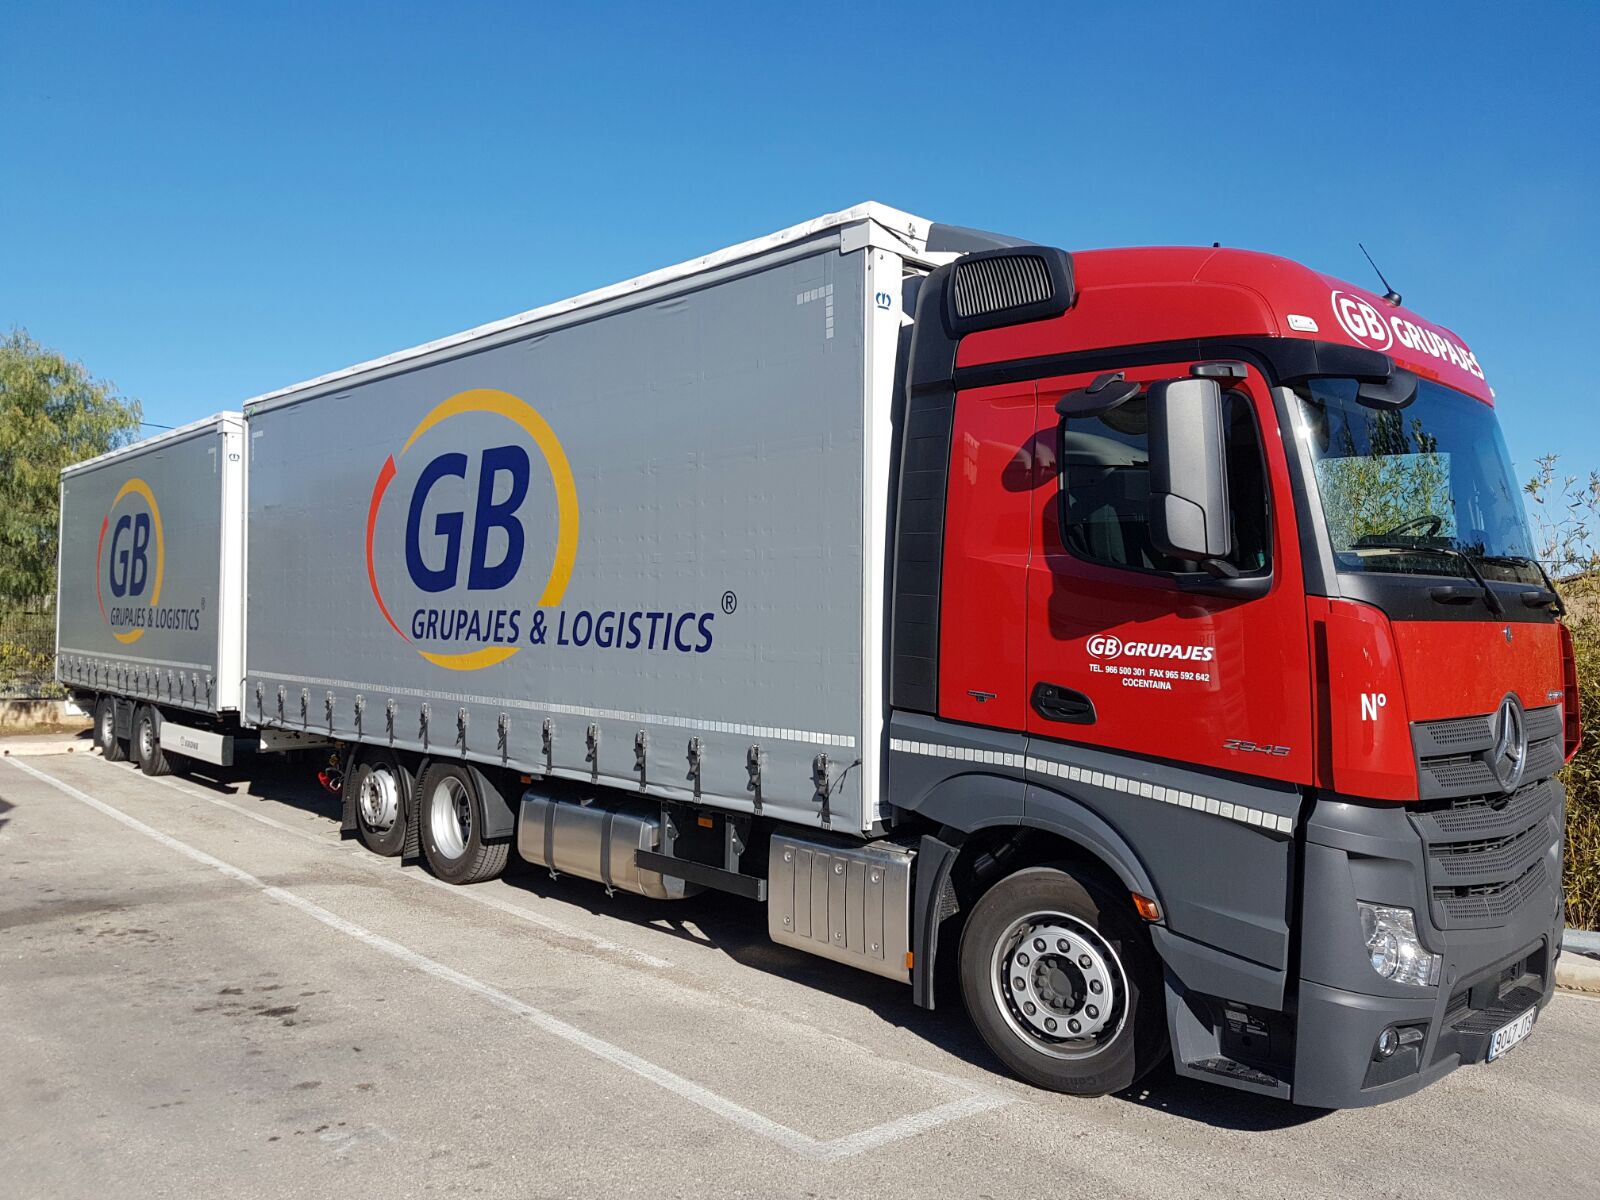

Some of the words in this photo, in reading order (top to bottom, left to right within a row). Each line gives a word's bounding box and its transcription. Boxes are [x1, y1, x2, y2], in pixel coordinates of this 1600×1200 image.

[1339, 298, 1386, 341] GB
[1390, 316, 1485, 380] GRUPAJES
[405, 445, 530, 593] GB
[110, 513, 150, 598] GB
[110, 607, 146, 627] GRUPAJES
[147, 608, 154, 628] &
[155, 608, 200, 630] LOGISTICS
[411, 608, 521, 644] GRUPAJES
[529, 610, 547, 645] &
[557, 611, 715, 653] LOGISTICS
[1090, 638, 1118, 656] GB
[1124, 642, 1214, 661] GRUPAJES
[1089, 664, 1104, 673] TEL.
[1105, 665, 1118, 674] 966
[1119, 666, 1132, 675] 500
[1133, 667, 1145, 676] 301
[1149, 669, 1164, 678] FAX
[1165, 671, 1179, 679] 965
[1180, 672, 1194, 681] 592
[1195, 673, 1210, 681] 642
[1122, 678, 1172, 690] COCENTAINA
